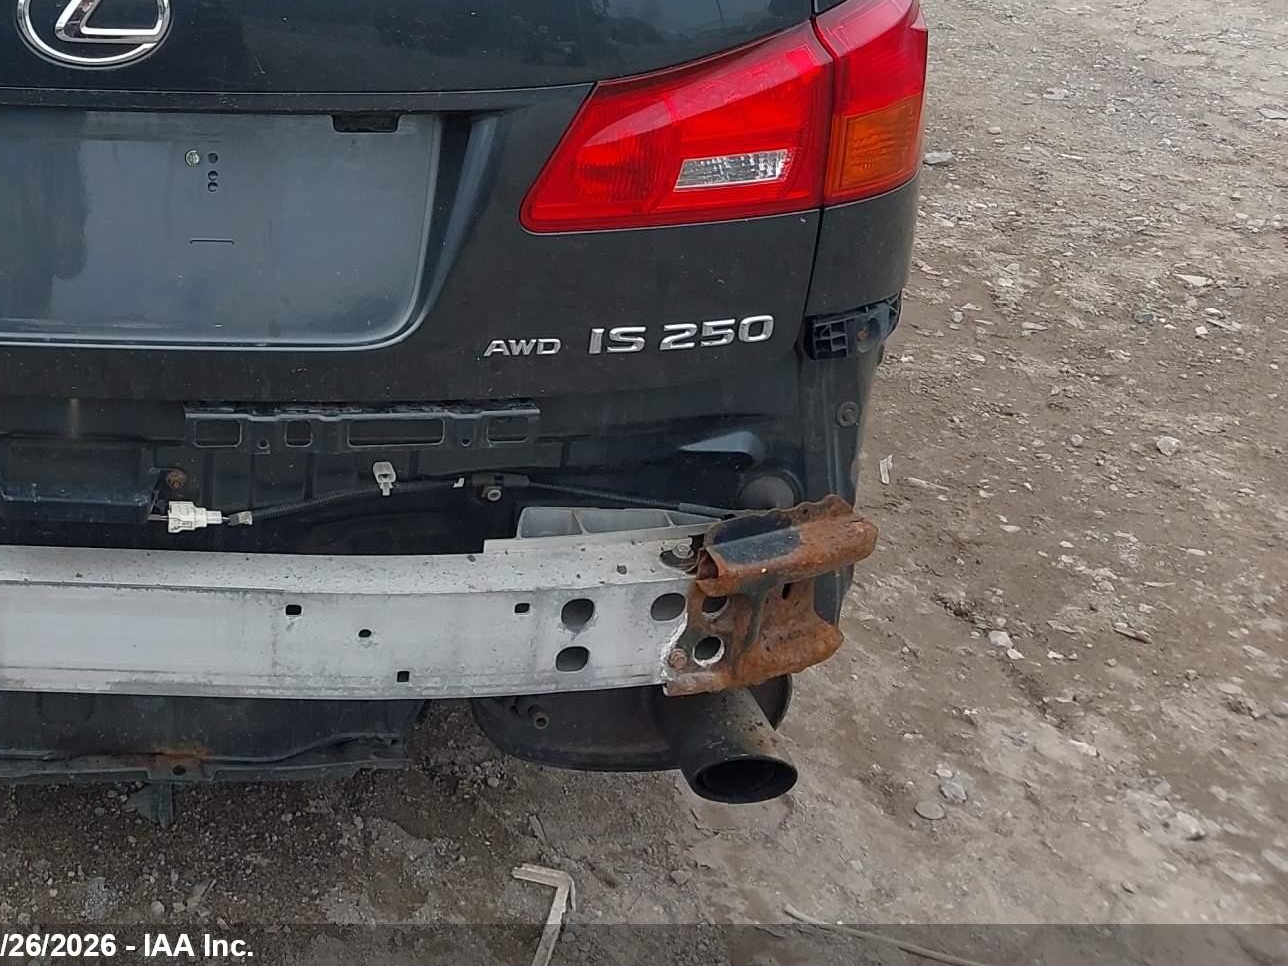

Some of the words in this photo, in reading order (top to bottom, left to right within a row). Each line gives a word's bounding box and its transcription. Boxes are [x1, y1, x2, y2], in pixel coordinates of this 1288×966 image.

[483, 337, 562, 357] AWD
[588, 326, 648, 355] IS
[658, 314, 775, 352] 250
